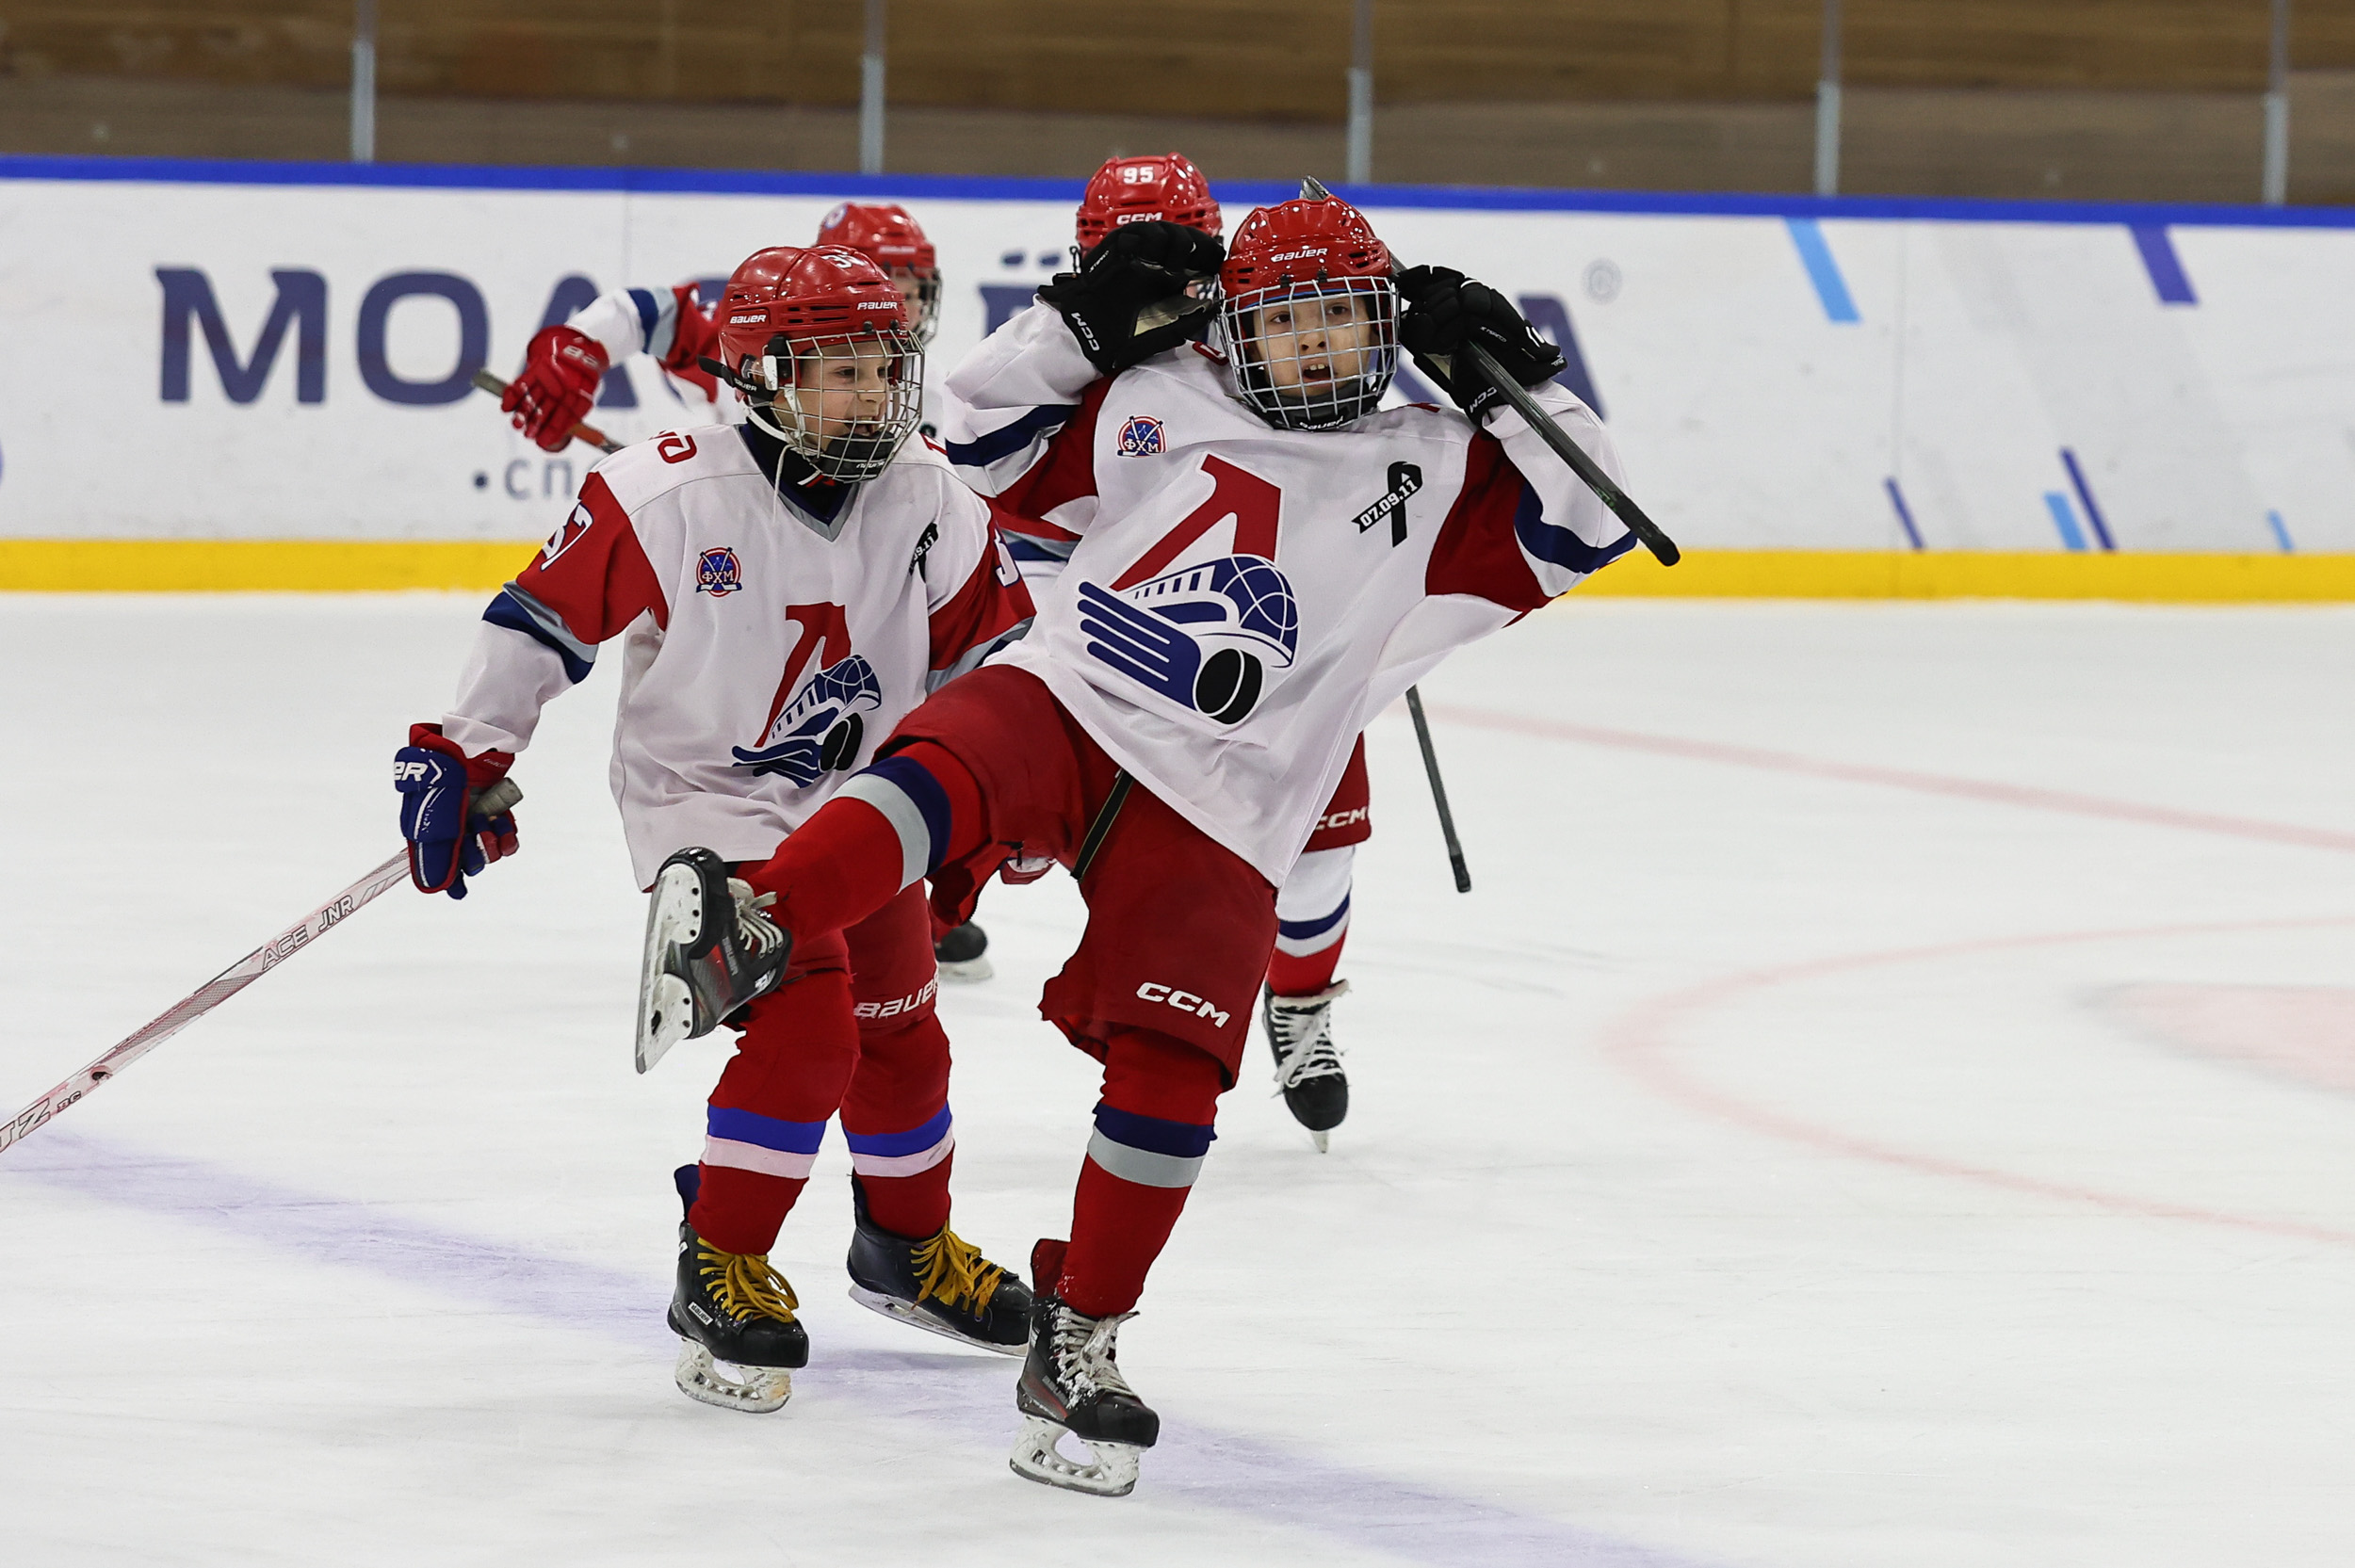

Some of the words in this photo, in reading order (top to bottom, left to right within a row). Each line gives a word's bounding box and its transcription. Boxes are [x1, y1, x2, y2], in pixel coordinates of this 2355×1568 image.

[1123, 166, 1154, 185] 95
[1116, 212, 1163, 225] CCM
[1271, 248, 1328, 263] BAUER
[857, 301, 898, 311] BAUER
[729, 315, 767, 324] BAUER
[1070, 312, 1100, 351] CCM
[1470, 386, 1497, 413] CCM
[1124, 438, 1160, 453] ФХМ
[1359, 479, 1418, 527] 07.09.11
[702, 569, 734, 584] ФХМ
[262, 924, 309, 971] ACE
[317, 894, 355, 933] JNR
[1135, 981, 1231, 1029] CCM
